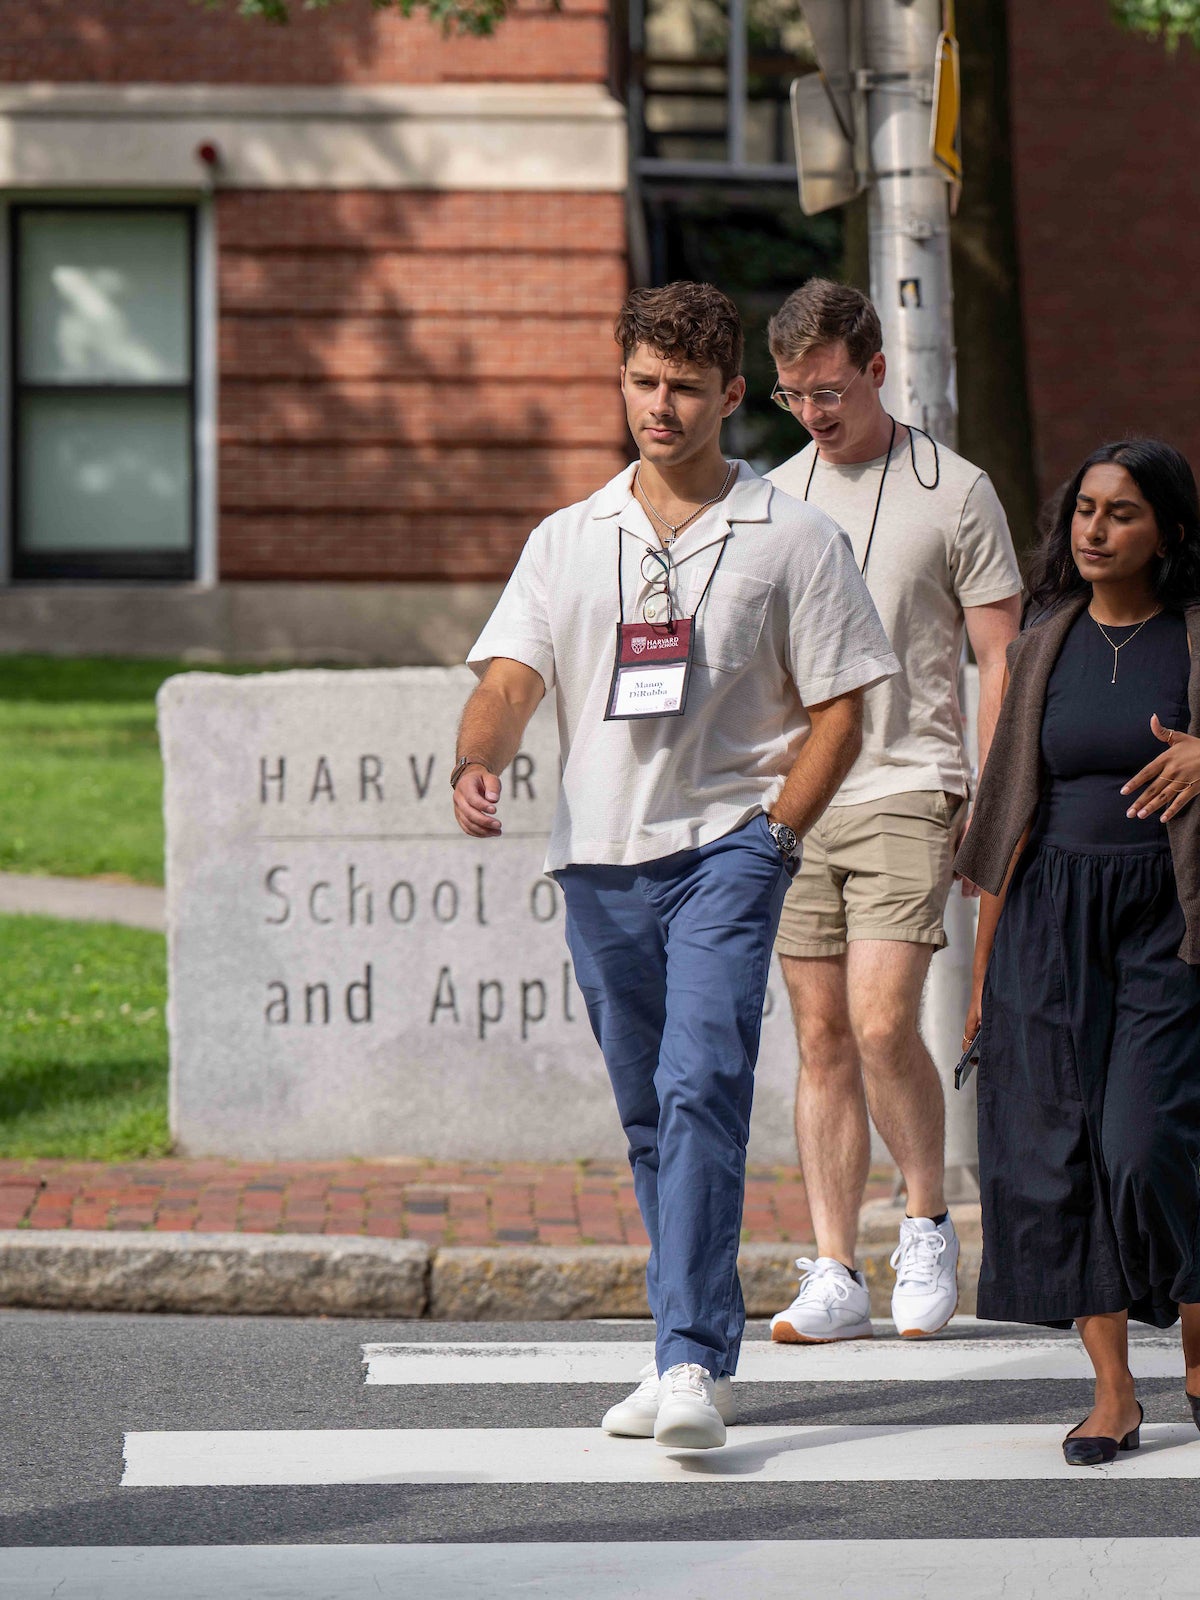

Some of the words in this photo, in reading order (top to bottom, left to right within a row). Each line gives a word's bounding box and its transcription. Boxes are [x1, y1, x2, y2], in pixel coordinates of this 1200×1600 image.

[647, 636, 679, 646] HARVARD
[259, 753, 563, 804] HARVR
[264, 864, 488, 927] School
[530, 879, 558, 922] o
[265, 962, 373, 1026] and
[429, 961, 576, 1040] Appl
